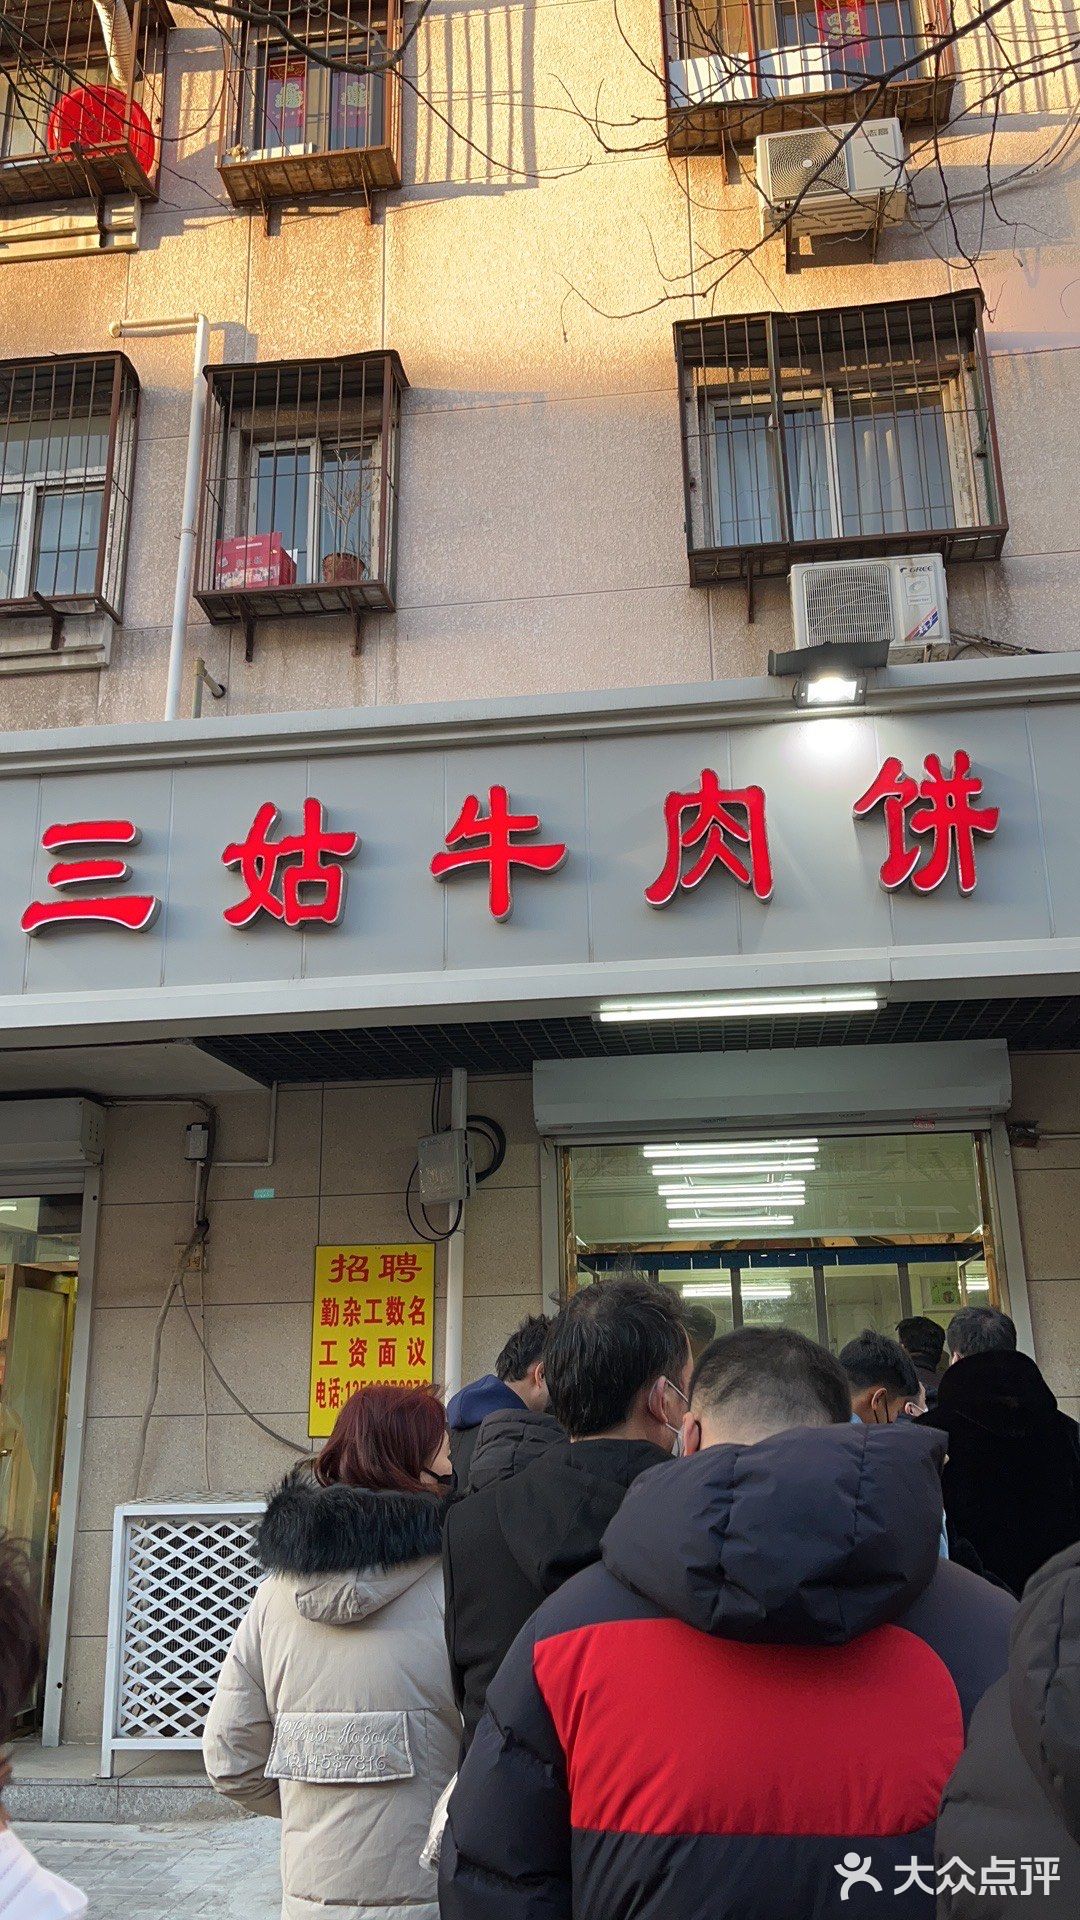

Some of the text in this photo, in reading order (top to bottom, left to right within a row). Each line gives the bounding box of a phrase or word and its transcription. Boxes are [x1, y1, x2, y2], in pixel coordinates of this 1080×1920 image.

[21, 749, 1000, 932] 三姑牛肉饼
[328, 1251, 423, 1284] 招聘
[320, 1295, 427, 1328] 勤杂工数名
[318, 1337, 427, 1368] 工资面议
